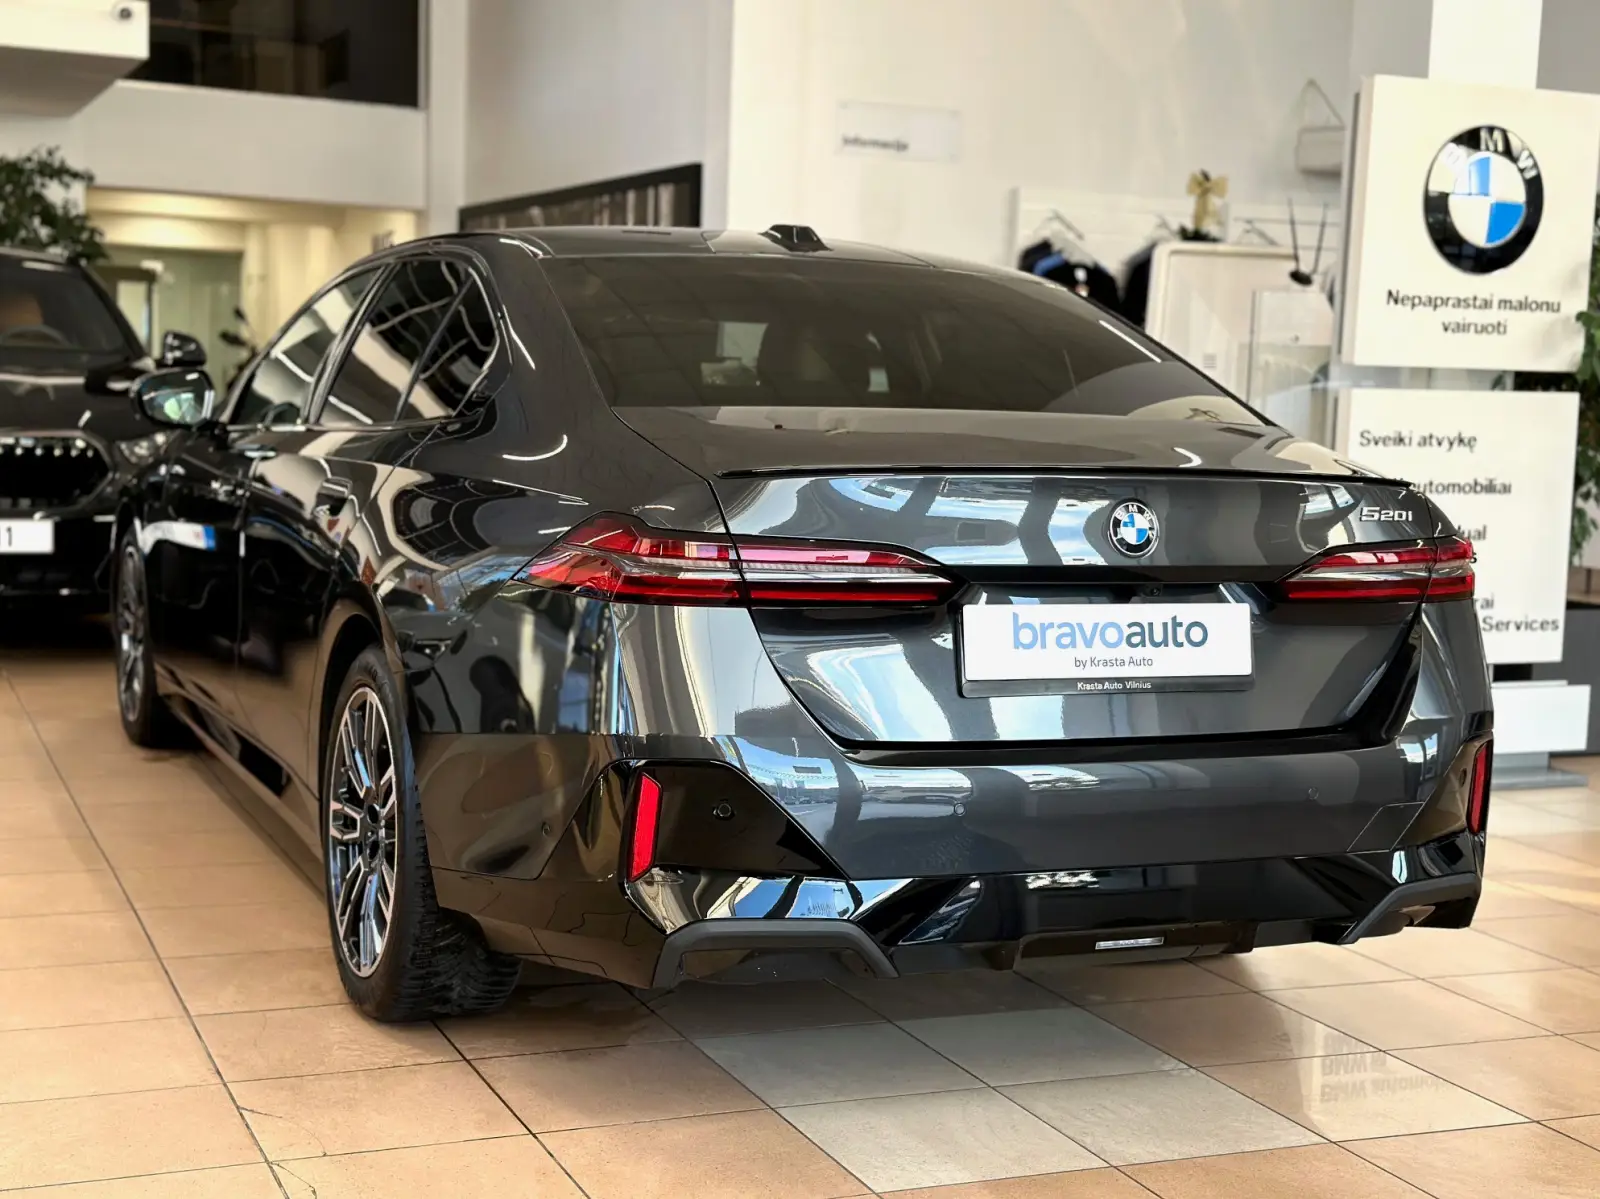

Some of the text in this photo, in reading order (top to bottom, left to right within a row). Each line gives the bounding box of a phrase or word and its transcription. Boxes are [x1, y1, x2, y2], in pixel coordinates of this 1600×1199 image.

[1386, 289, 1561, 312] Nepaprastai malonu
[1442, 318, 1508, 335] vairuoti
[1359, 429, 1477, 453] Sveiki atvykę
[1012, 611, 1208, 650] bravoauto
[1481, 614, 1560, 632] Services
[1074, 656, 1154, 670] by Krasta Auto
[1077, 680, 1152, 690] Krasta Auto Vilnius
